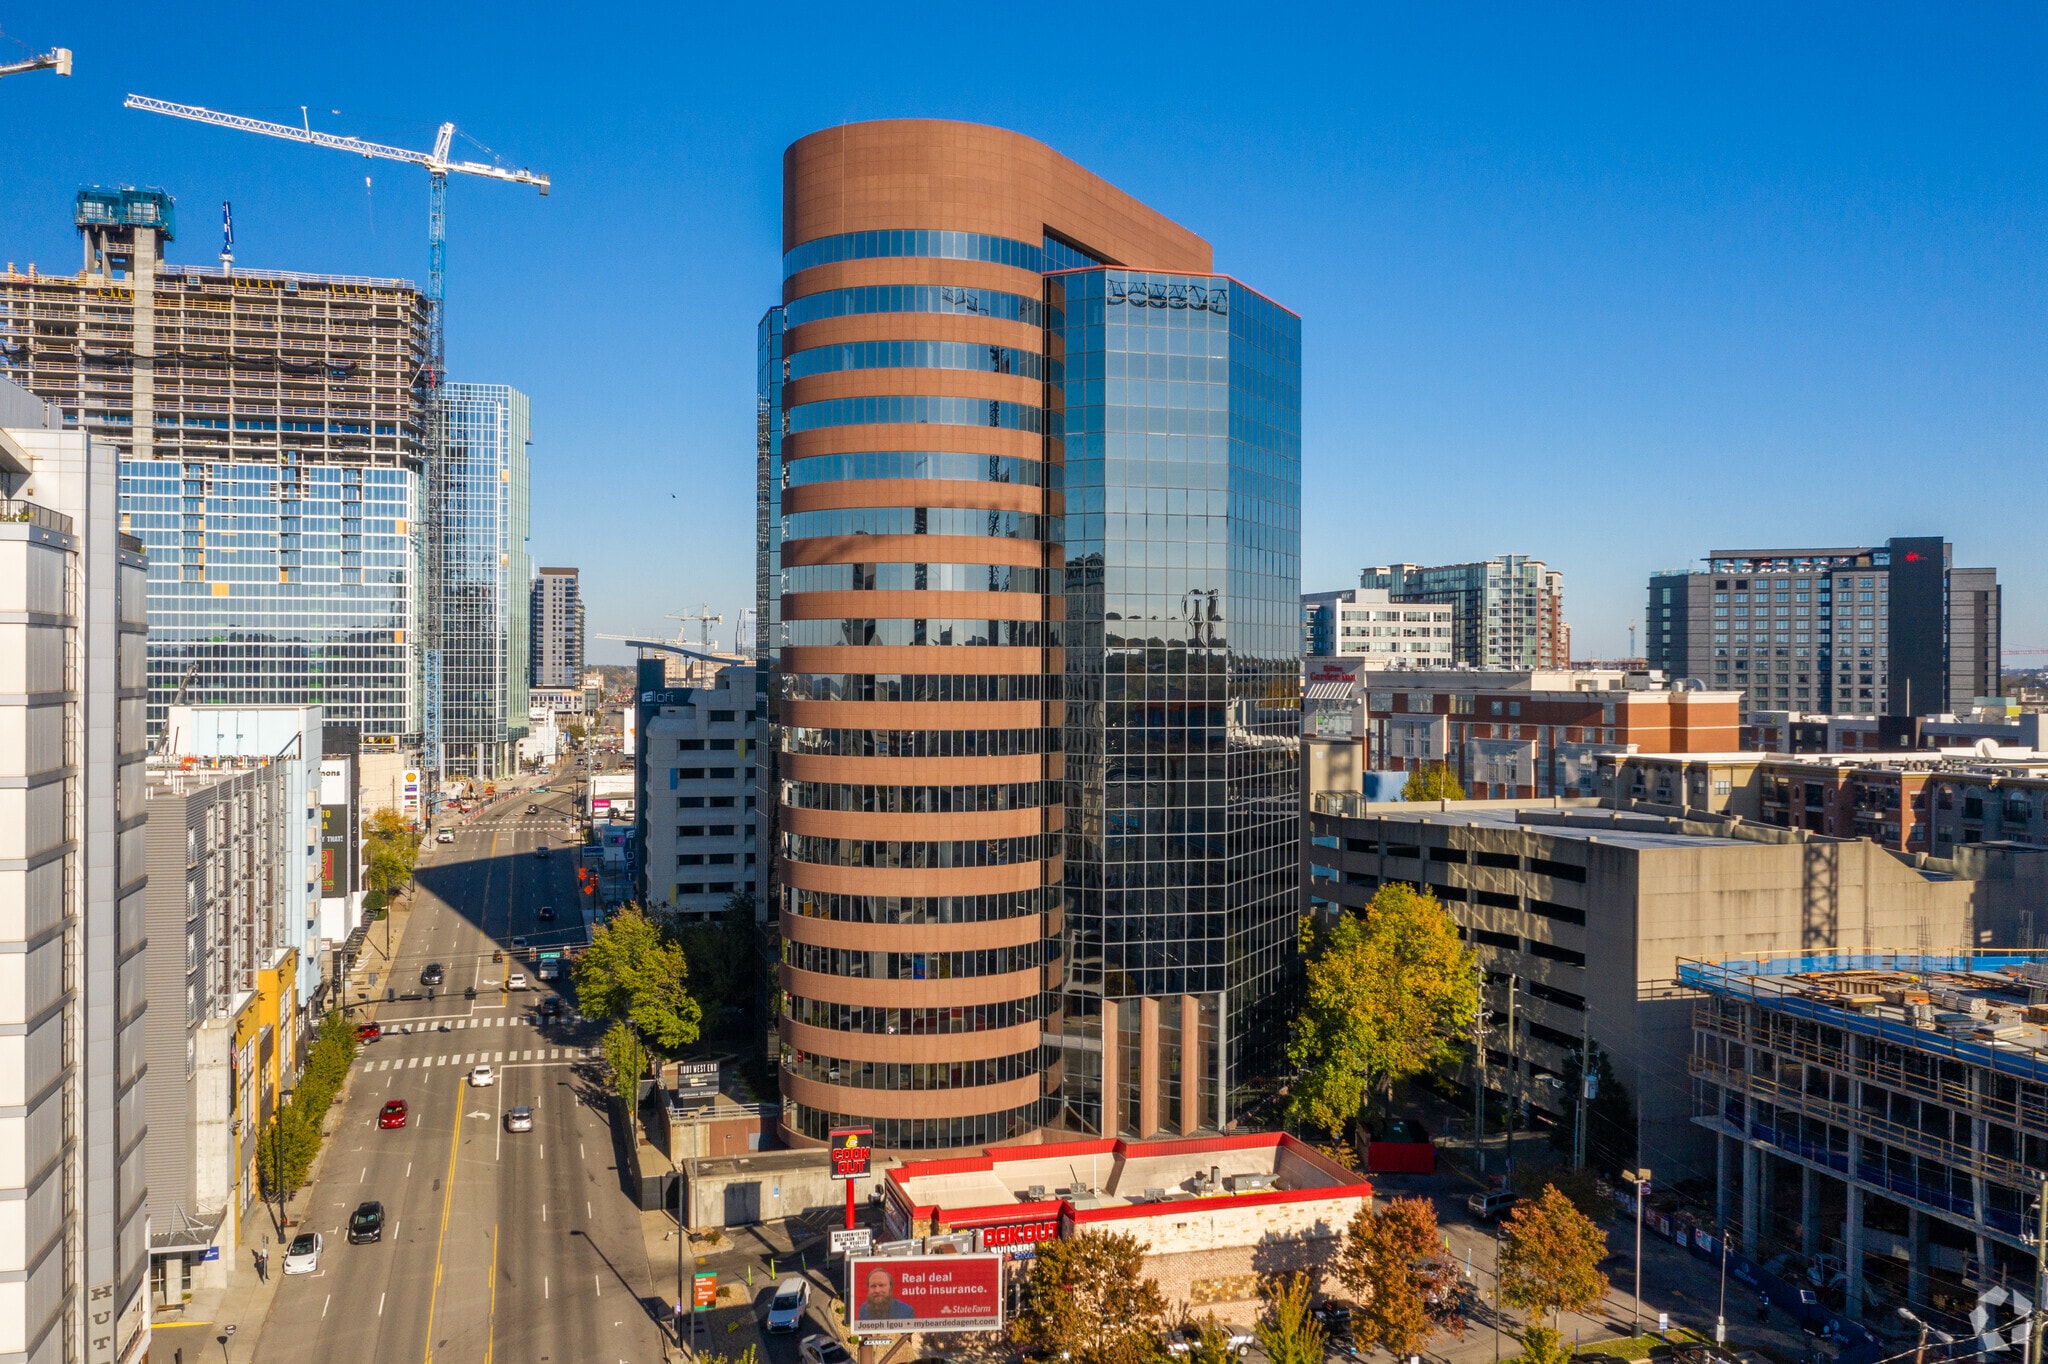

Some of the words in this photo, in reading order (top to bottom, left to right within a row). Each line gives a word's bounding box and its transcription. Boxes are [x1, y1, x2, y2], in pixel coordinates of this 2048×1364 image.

[642, 690, 674, 703] aloft
[693, 1063, 706, 1073] WEST
[707, 1063, 717, 1072] END
[832, 1146, 871, 1162] COOK
[837, 1159, 866, 1175] OUT
[982, 1224, 1023, 1247] OOK
[902, 1272, 926, 1283] Real
[928, 1271, 953, 1283] deal
[901, 1286, 927, 1296] auto
[929, 1284, 987, 1295] insurance.
[91, 1285, 112, 1364] HUT
[857, 1321, 885, 1330] Joseph
[886, 1320, 903, 1329] Igou
[913, 1318, 996, 1328] mybeardedagent.com
